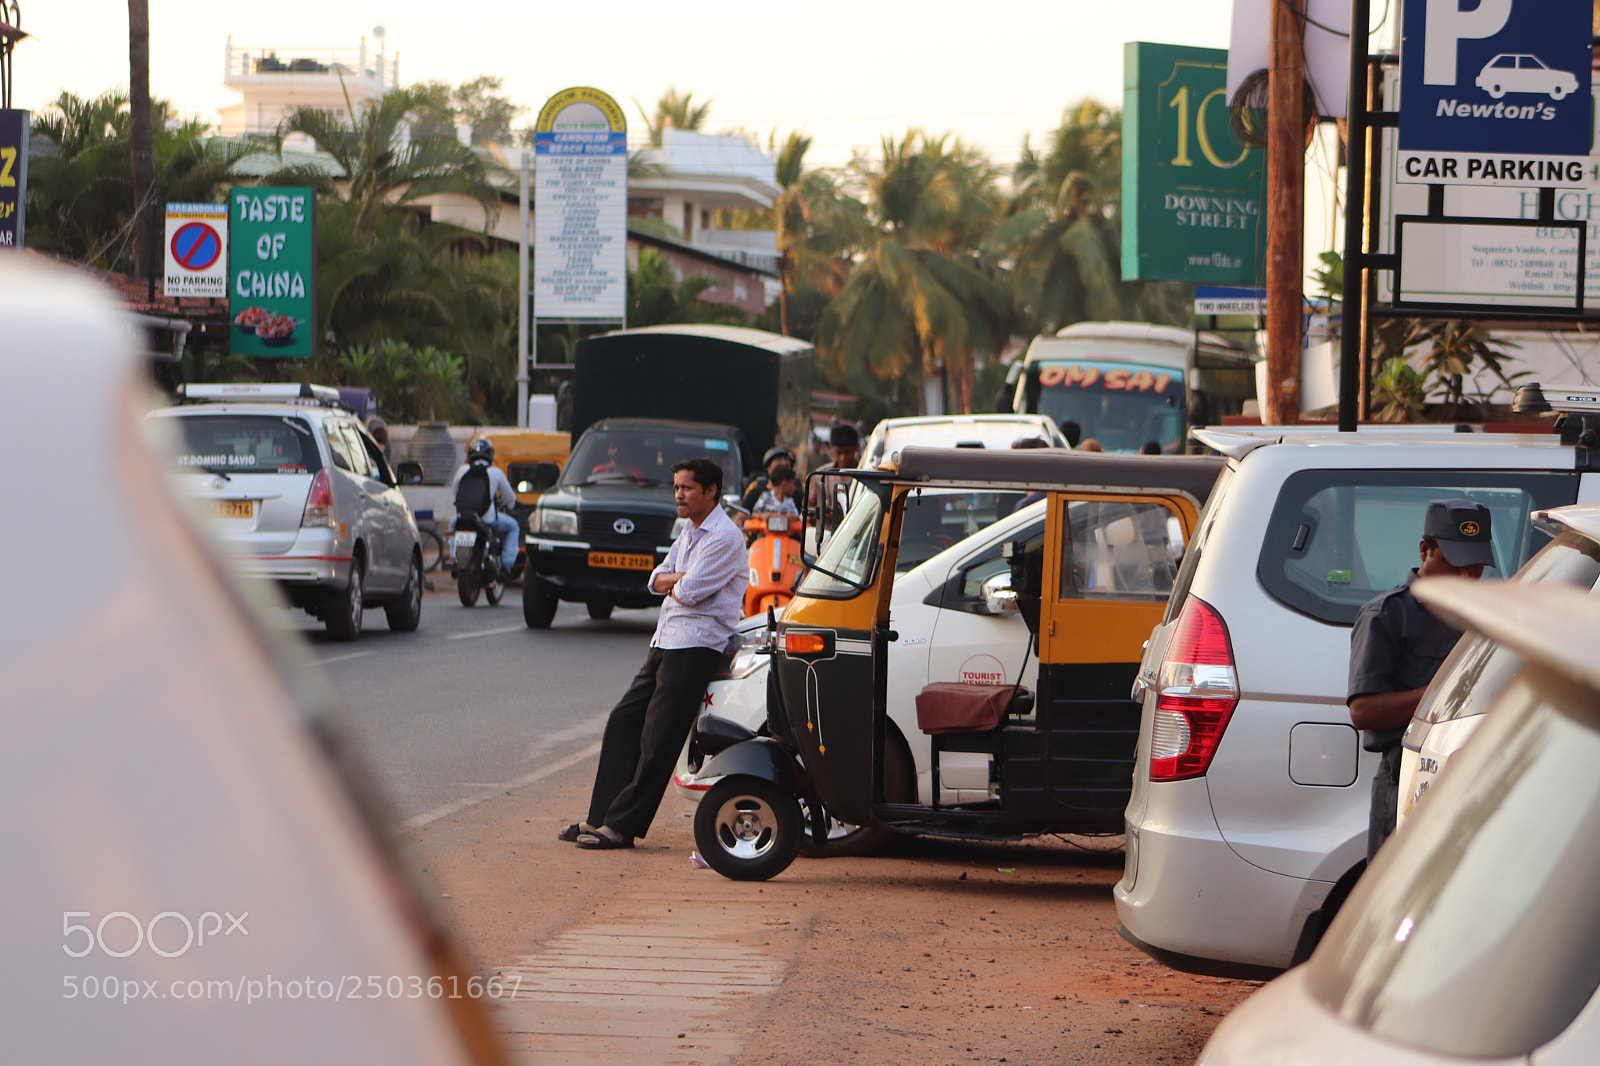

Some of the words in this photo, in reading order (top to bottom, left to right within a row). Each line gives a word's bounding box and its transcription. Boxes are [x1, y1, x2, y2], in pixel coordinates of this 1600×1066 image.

[1424, 0, 1512, 86] P
[1435, 99, 1556, 121] Newton's
[549, 144, 583, 153] BEACH
[584, 144, 614, 153] ROAD
[554, 134, 609, 143] CANDOLIM
[1405, 156, 1458, 180] CAR
[1467, 158, 1583, 182] PARKING
[236, 195, 305, 223] TASTE
[1164, 193, 1258, 216] DOWNING
[1518, 191, 1600, 221] HGH
[1176, 211, 1248, 230] STREET
[256, 234, 287, 260] OF
[167, 276, 181, 285] NO
[184, 276, 223, 286] PARKING
[236, 270, 305, 299] CHINA
[1199, 302, 1215, 312] TWO
[1217, 302, 1255, 312] WHEELERS
[1039, 365, 1100, 388] OM
[1103, 368, 1172, 394] SAI
[228, 455, 256, 465] SAVIO
[593, 554, 605, 565] GA
[608, 556, 617, 566] 01
[963, 671, 1001, 681] TOURIST
